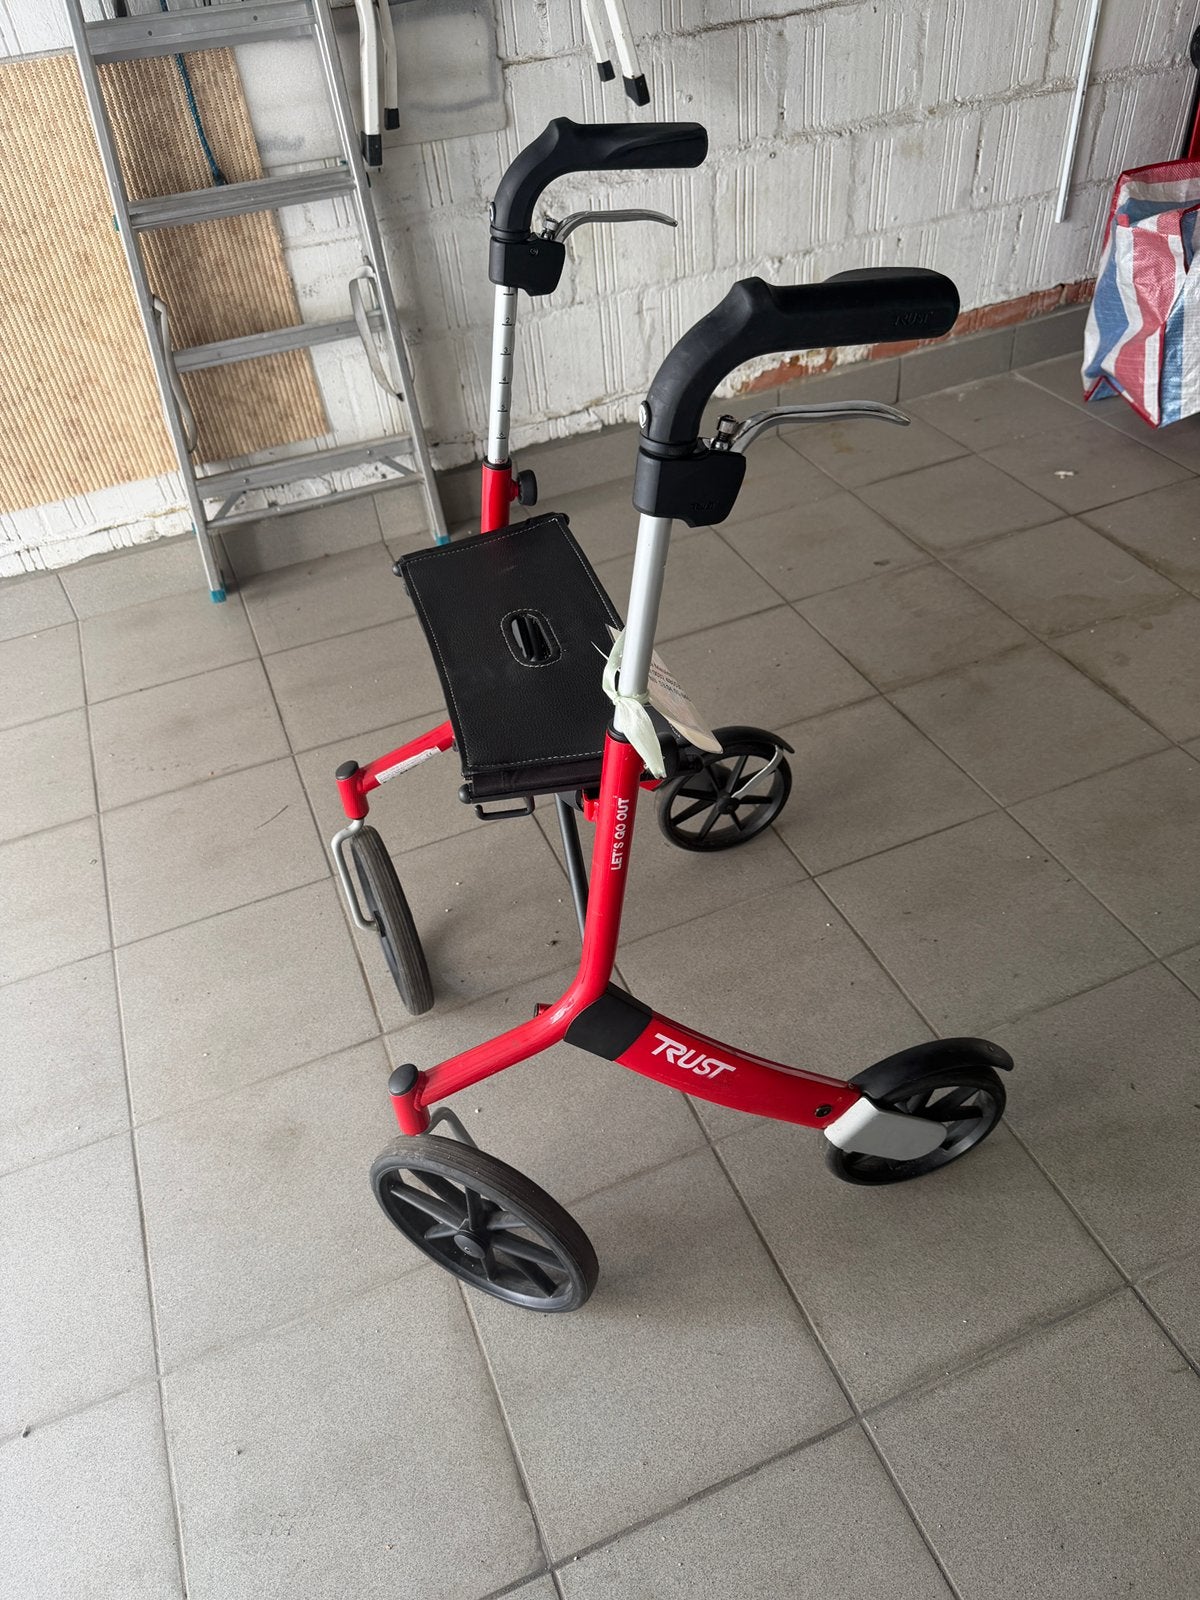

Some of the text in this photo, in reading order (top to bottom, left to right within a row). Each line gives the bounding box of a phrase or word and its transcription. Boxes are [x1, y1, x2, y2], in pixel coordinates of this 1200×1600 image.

[611, 797, 629, 870] LET'S GO OUT
[651, 1032, 737, 1079] TRUST
